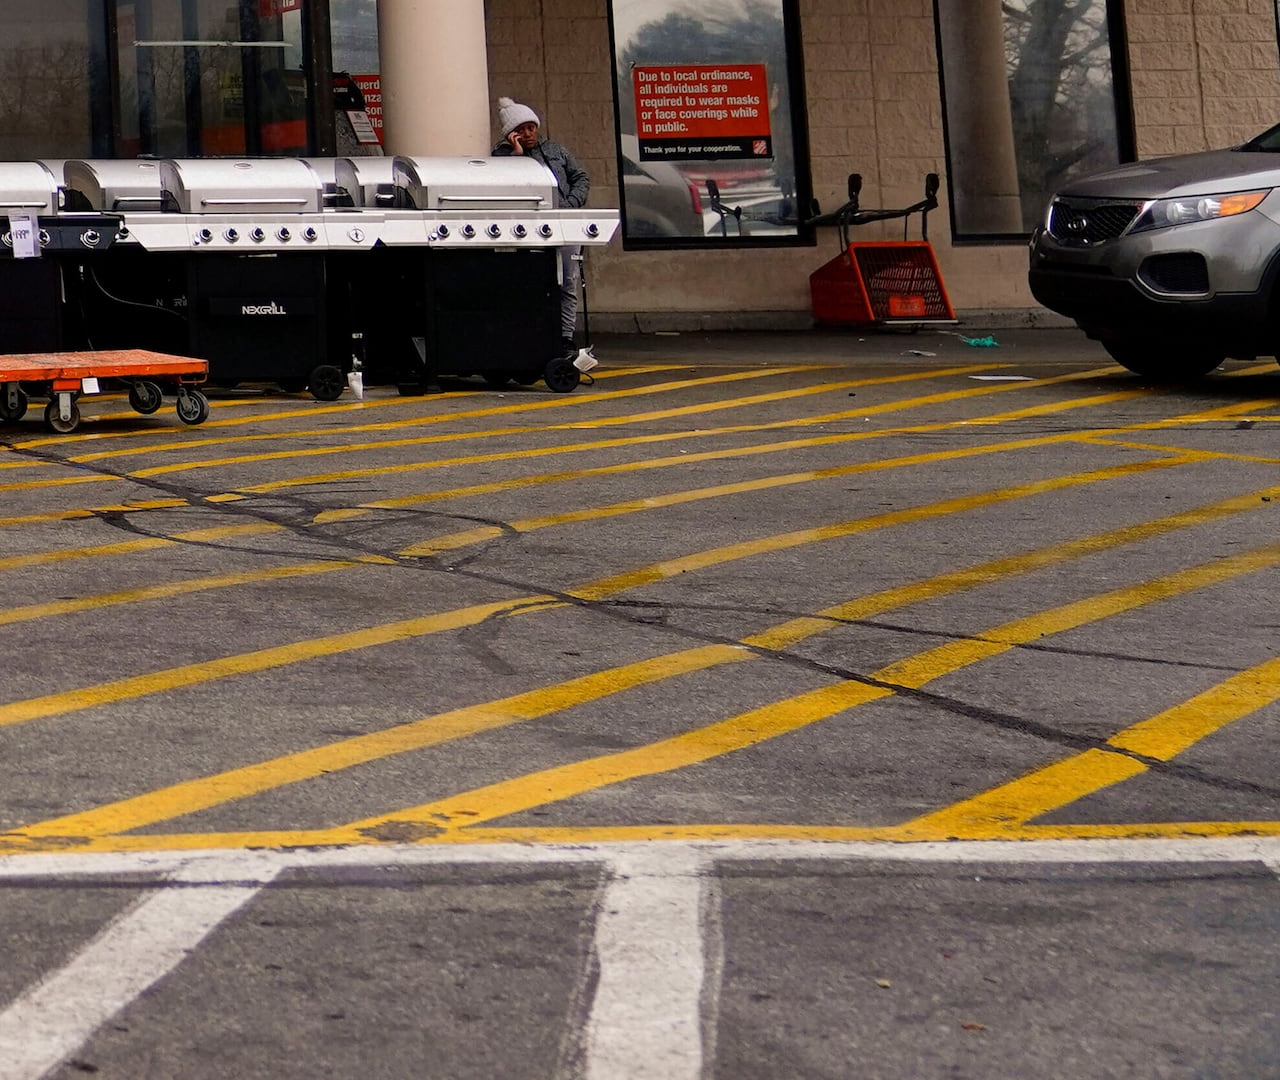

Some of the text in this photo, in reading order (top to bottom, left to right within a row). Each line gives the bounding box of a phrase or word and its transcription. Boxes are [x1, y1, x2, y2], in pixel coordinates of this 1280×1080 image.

[638, 70, 753, 82] Due to local ordinance,
[640, 83, 728, 94] all individuals are
[640, 95, 760, 108] required to wear masks
[642, 107, 758, 120] or face coverings while
[642, 121, 688, 134] in public.
[644, 146, 663, 154] Thank
[703, 145, 742, 153] cooperation.
[242, 300, 286, 314] NEXGRILL
